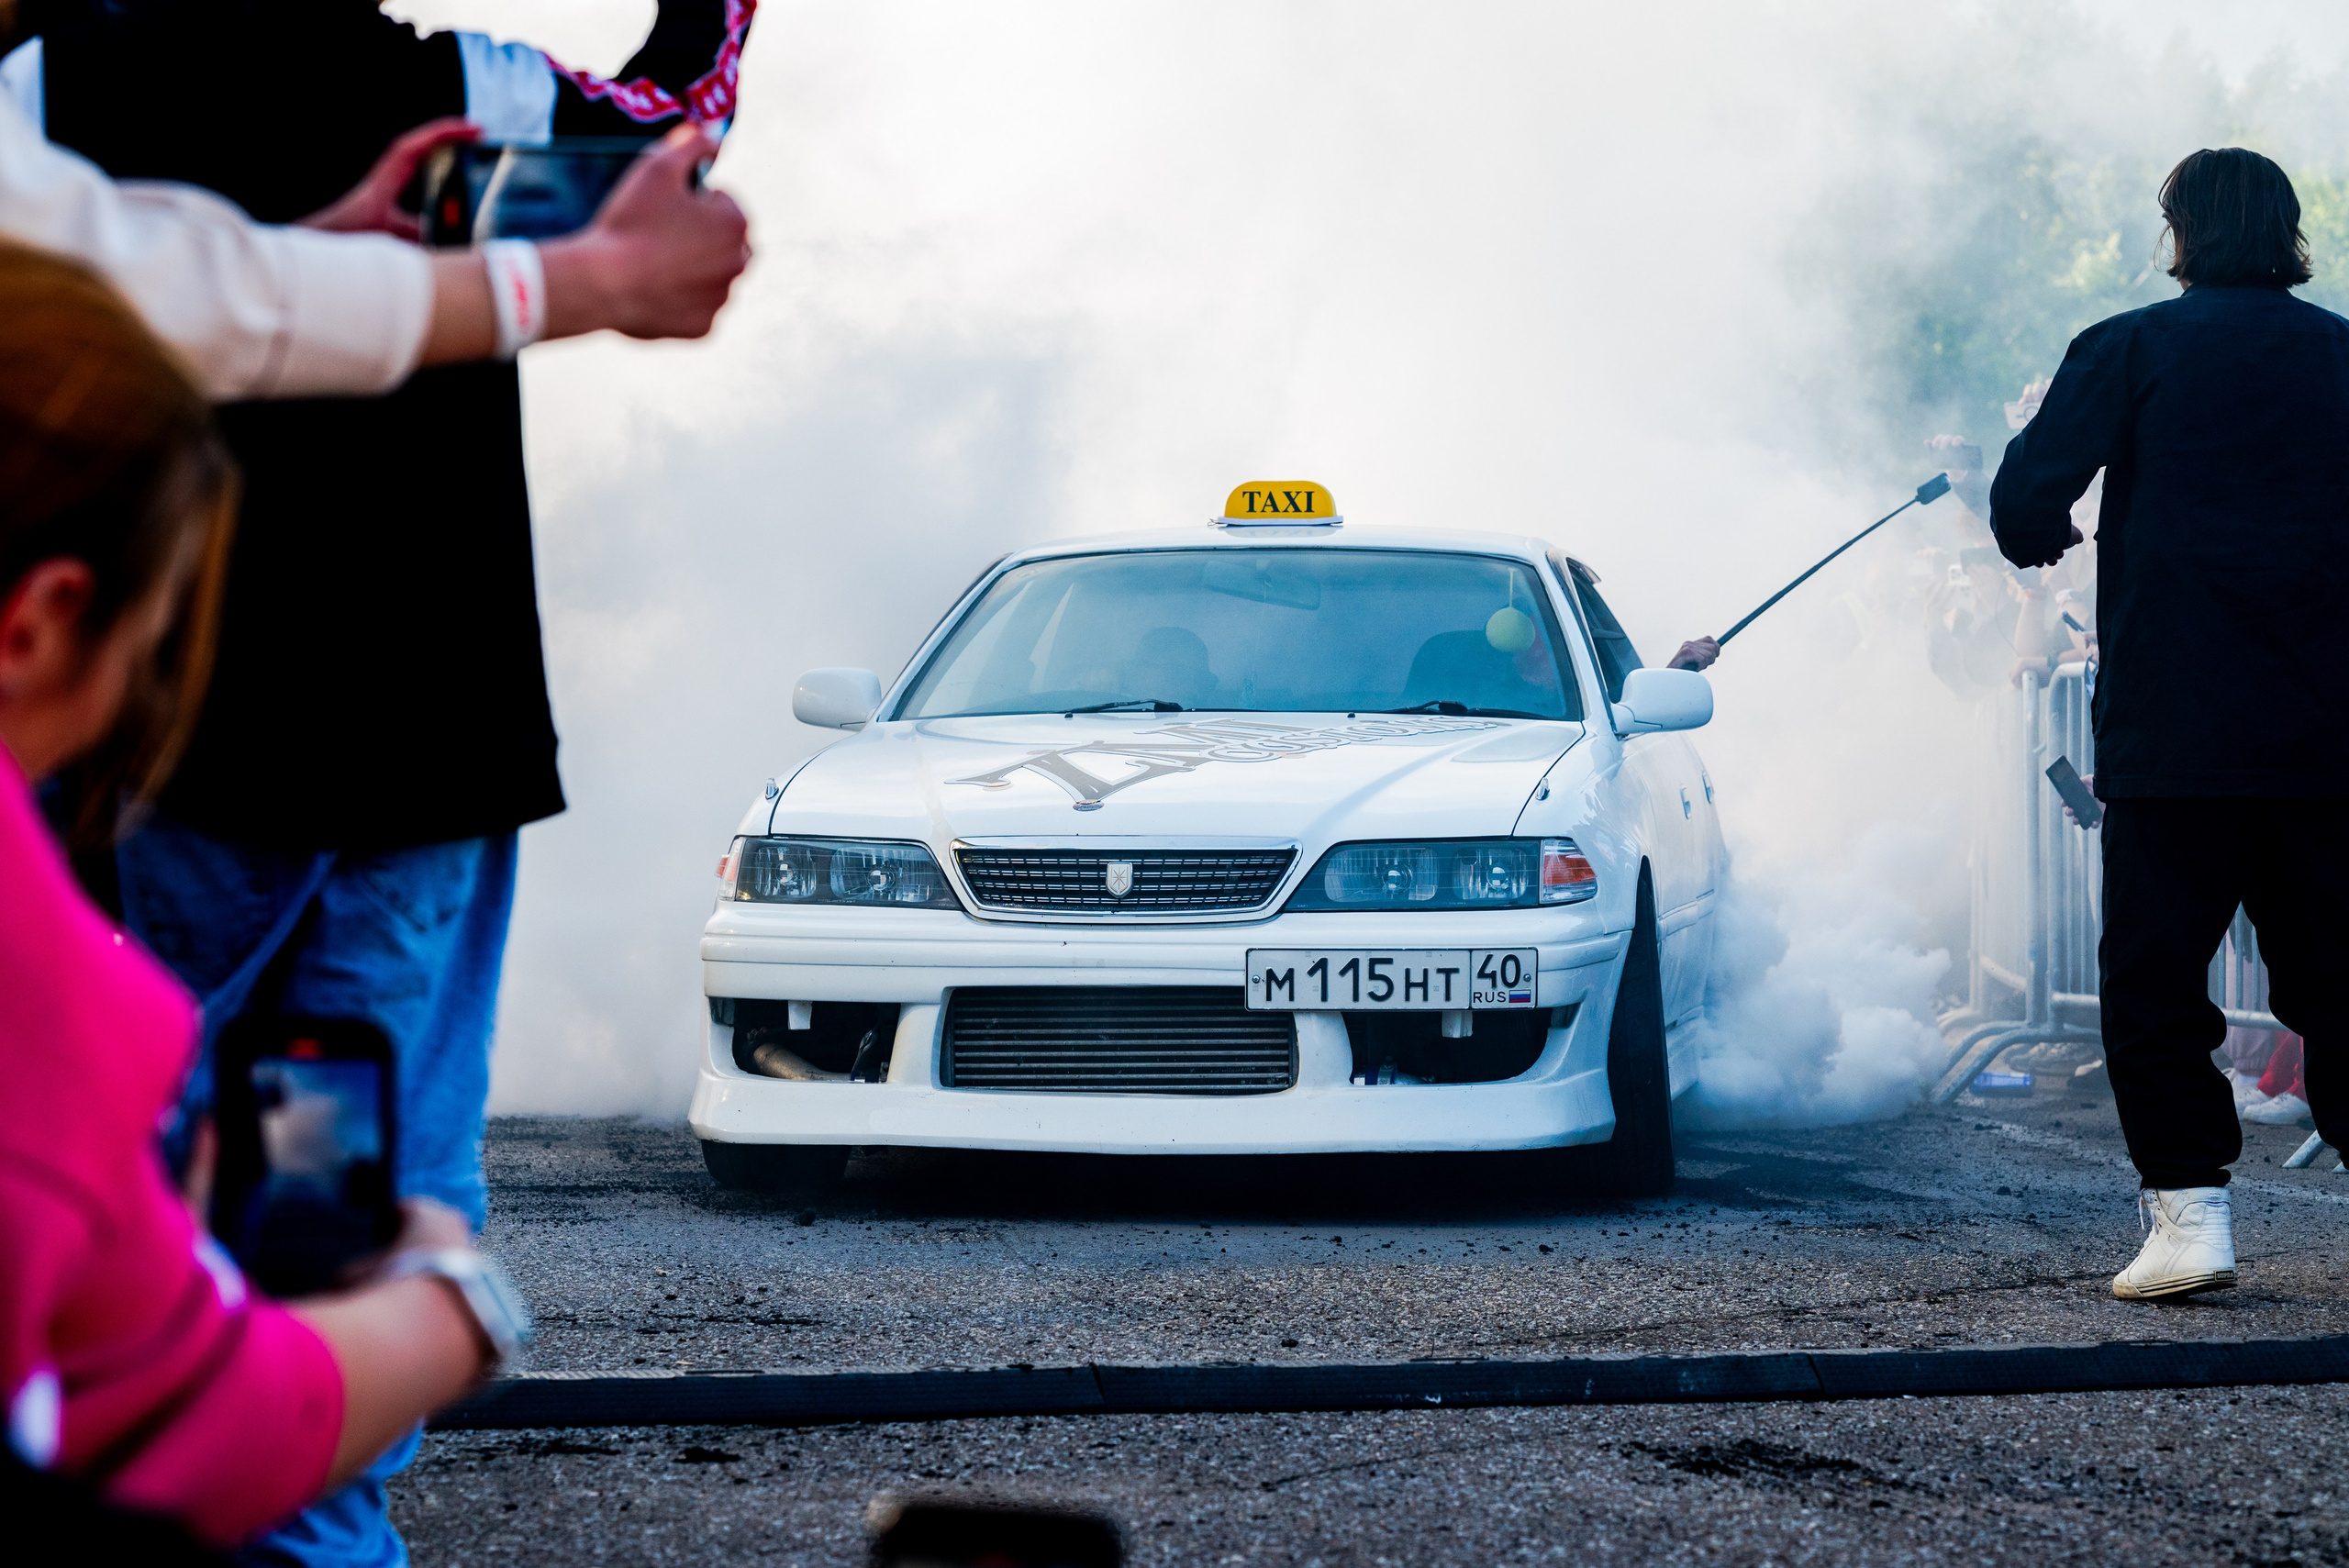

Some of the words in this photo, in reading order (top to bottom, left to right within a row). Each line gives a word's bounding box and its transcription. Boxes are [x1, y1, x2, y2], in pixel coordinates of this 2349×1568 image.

[1242, 491, 1315, 513] TAXI
[1476, 953, 1521, 988] 40
[1473, 992, 1507, 1003] RUS
